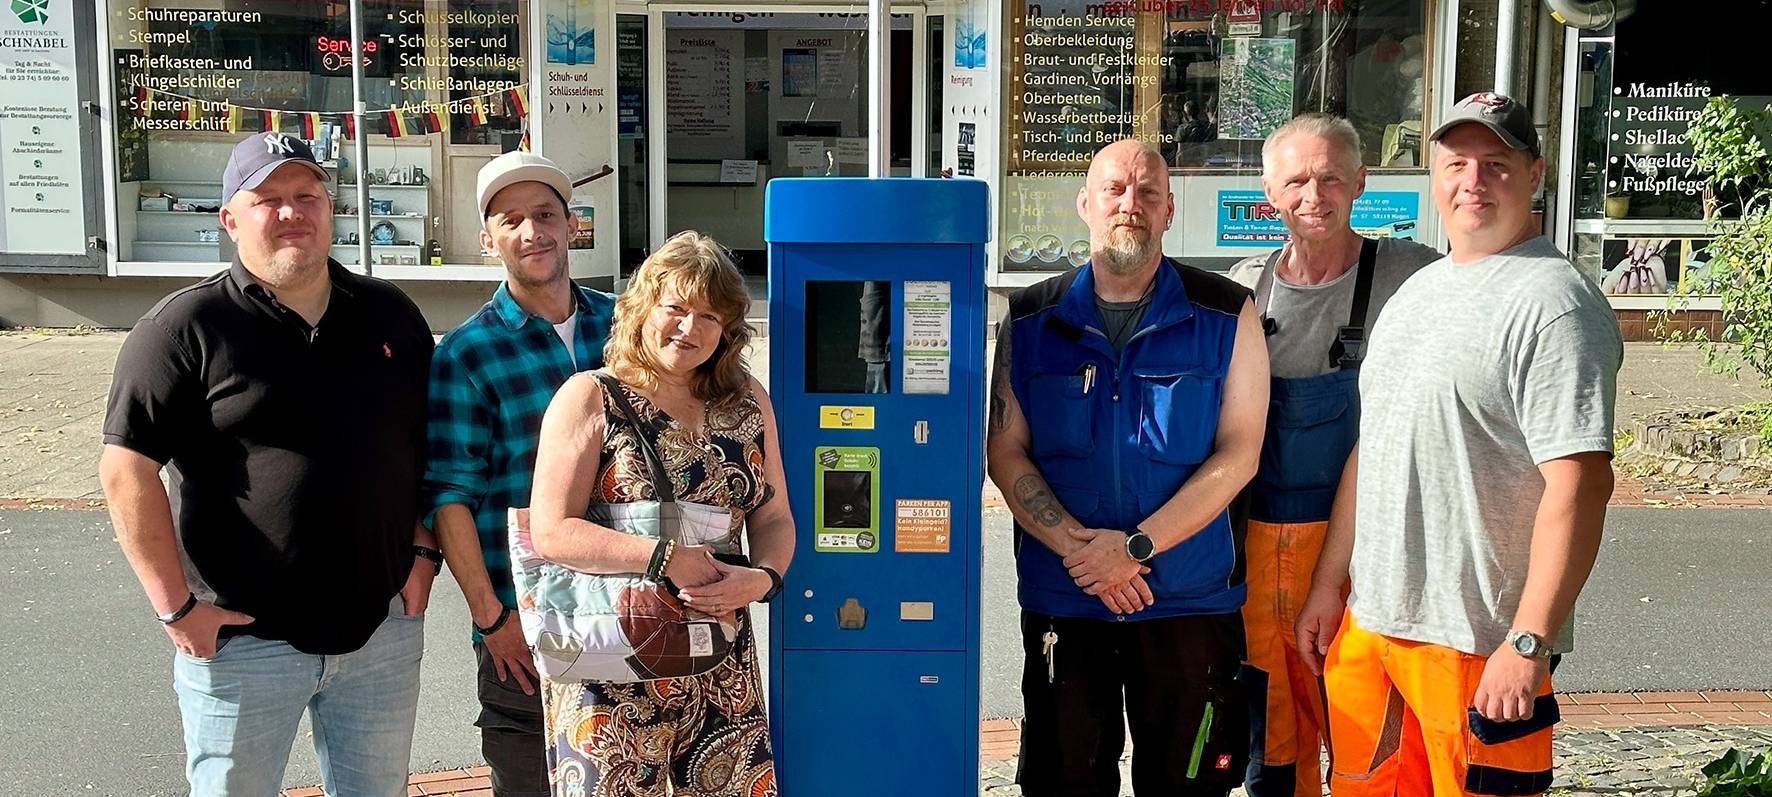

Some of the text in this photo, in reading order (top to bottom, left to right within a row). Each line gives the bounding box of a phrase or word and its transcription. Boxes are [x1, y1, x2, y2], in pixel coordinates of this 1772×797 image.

[128, 7, 261, 25] Schuhreparaturen
[399, 10, 519, 28] Schlüsselkopien
[1025, 15, 1135, 28] Hemden Service
[129, 30, 190, 47] Stempel
[399, 34, 507, 48] Schlösser- und
[796, 38, 832, 47] ANGEBOT
[1024, 34, 1134, 49] Oberbekleidung
[130, 55, 252, 70] Briefkasten- und
[400, 54, 525, 71] Schutzbeschläge
[1024, 54, 1174, 67] Braut- und Festkleider
[131, 73, 242, 91] Klingelschilder
[548, 72, 588, 82] Schuh- und
[951, 75, 973, 87] Reinigung
[1024, 73, 1157, 89] Gardinen, Vorhänge
[549, 86, 604, 97] Schlüsseldienst
[1627, 82, 1711, 98] Maniküre
[129, 97, 230, 112] Scheren- und
[1023, 92, 1101, 104] Oberbetten
[401, 100, 495, 114] Außendienst
[1626, 106, 1701, 122] Pediküre
[133, 116, 231, 132] Messerschliff
[1023, 111, 1149, 127] Wasserbettbezüge
[263, 133, 295, 154] NY
[1023, 131, 1174, 144] Tisch- und Bettwäsche
[1624, 129, 1686, 145] Shellac
[1022, 150, 1095, 162] Pferdedec
[1022, 169, 1090, 180] Lederrein
[1623, 176, 1705, 195] Fußpflege
[1223, 201, 1275, 220] TTR
[912, 508, 946, 517] 586101
[914, 518, 948, 526] Kleingeld?
